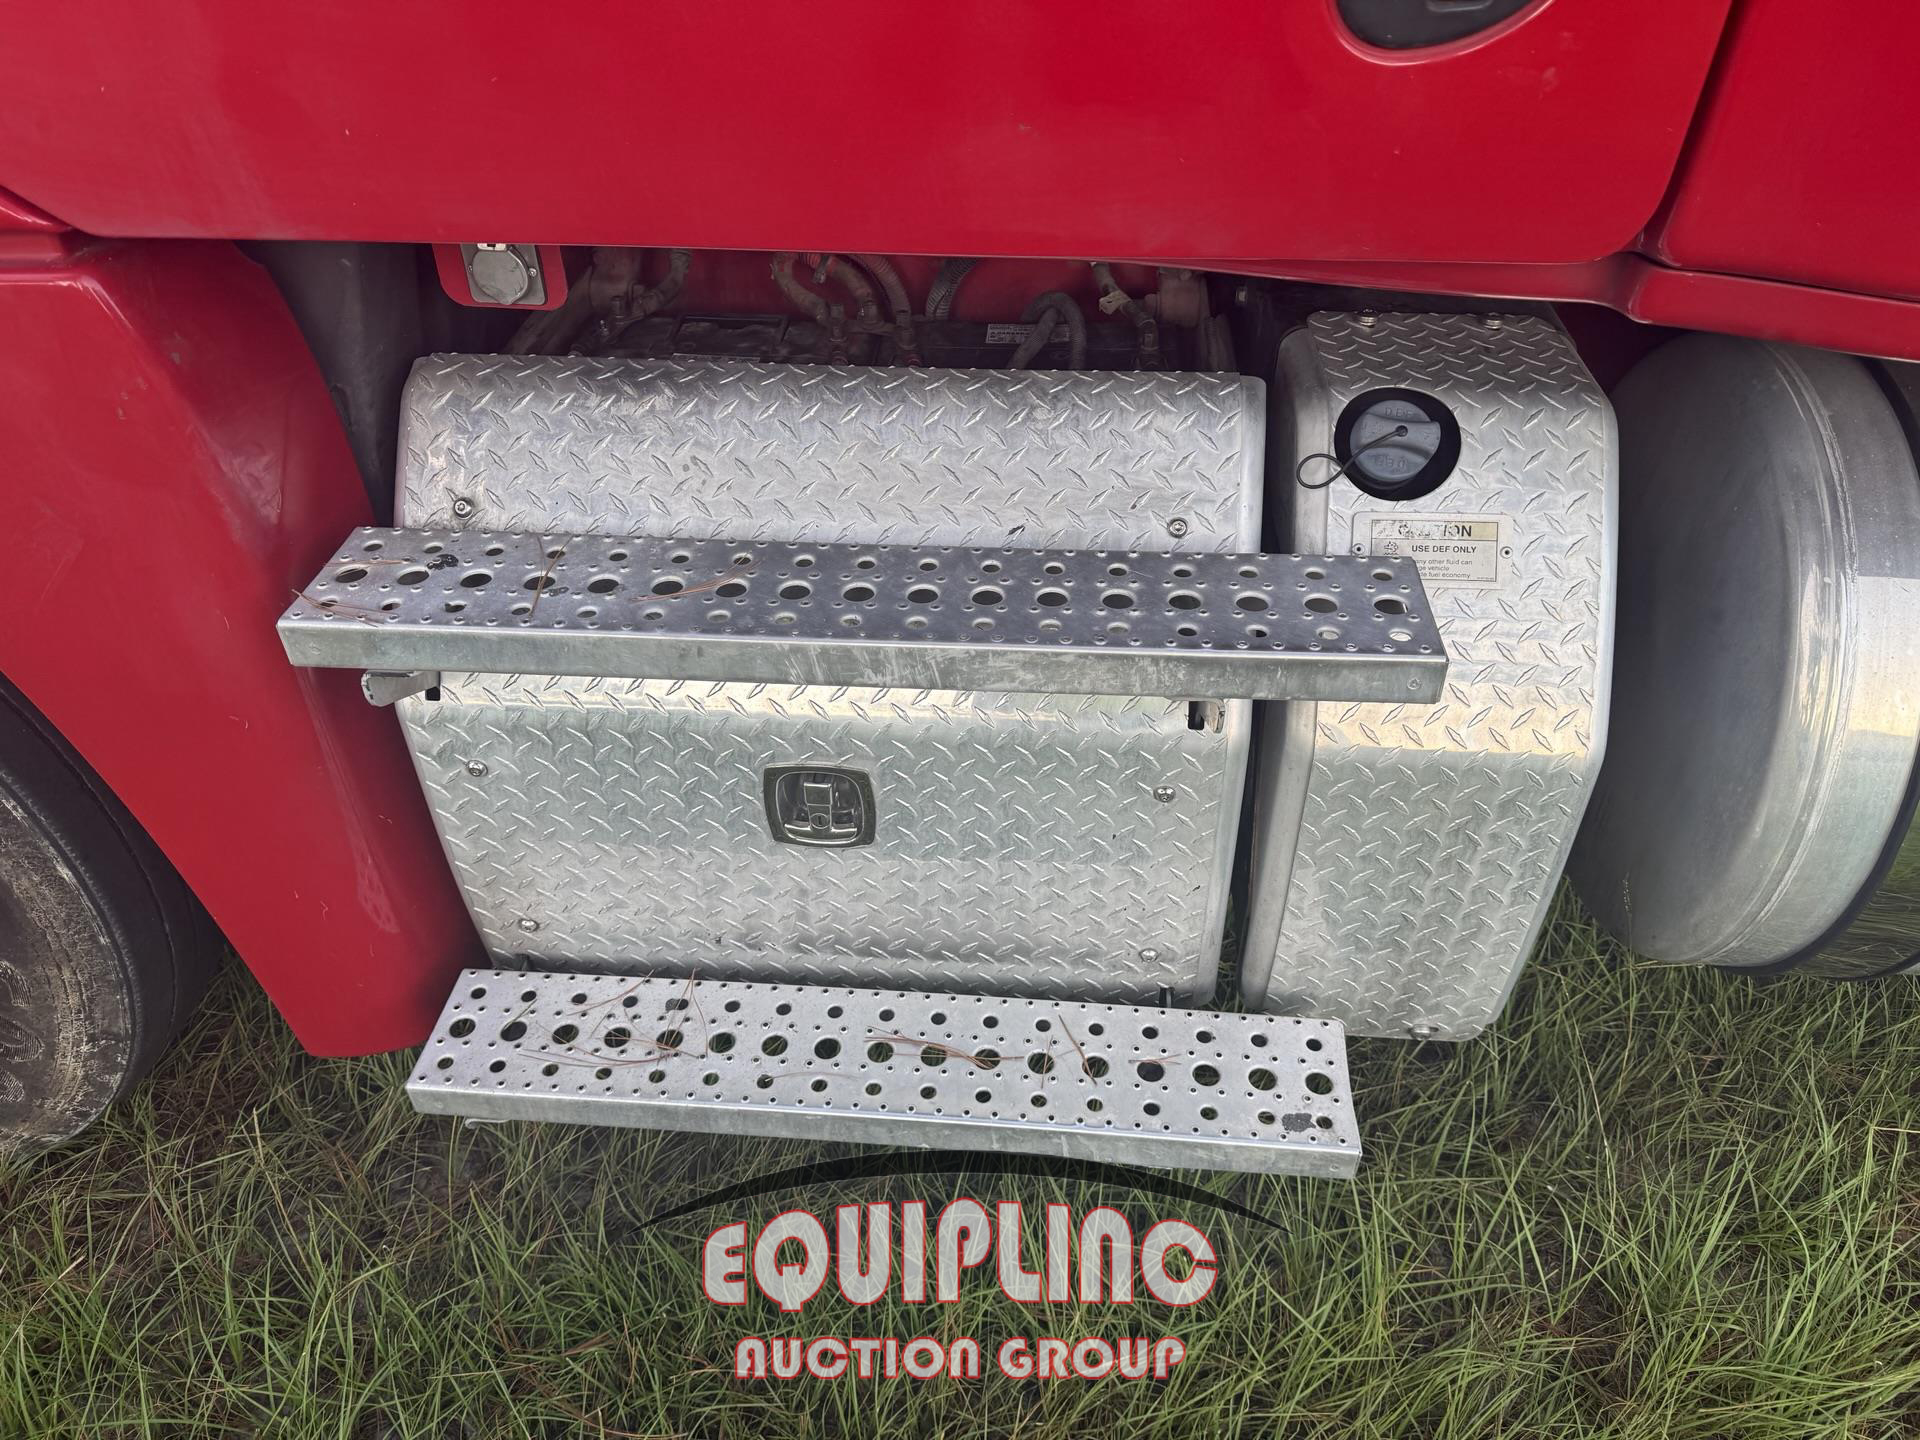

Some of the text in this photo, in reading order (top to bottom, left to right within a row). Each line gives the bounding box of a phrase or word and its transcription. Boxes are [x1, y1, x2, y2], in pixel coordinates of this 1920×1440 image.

[1411, 545, 1477, 554] USE DEF ONLY
